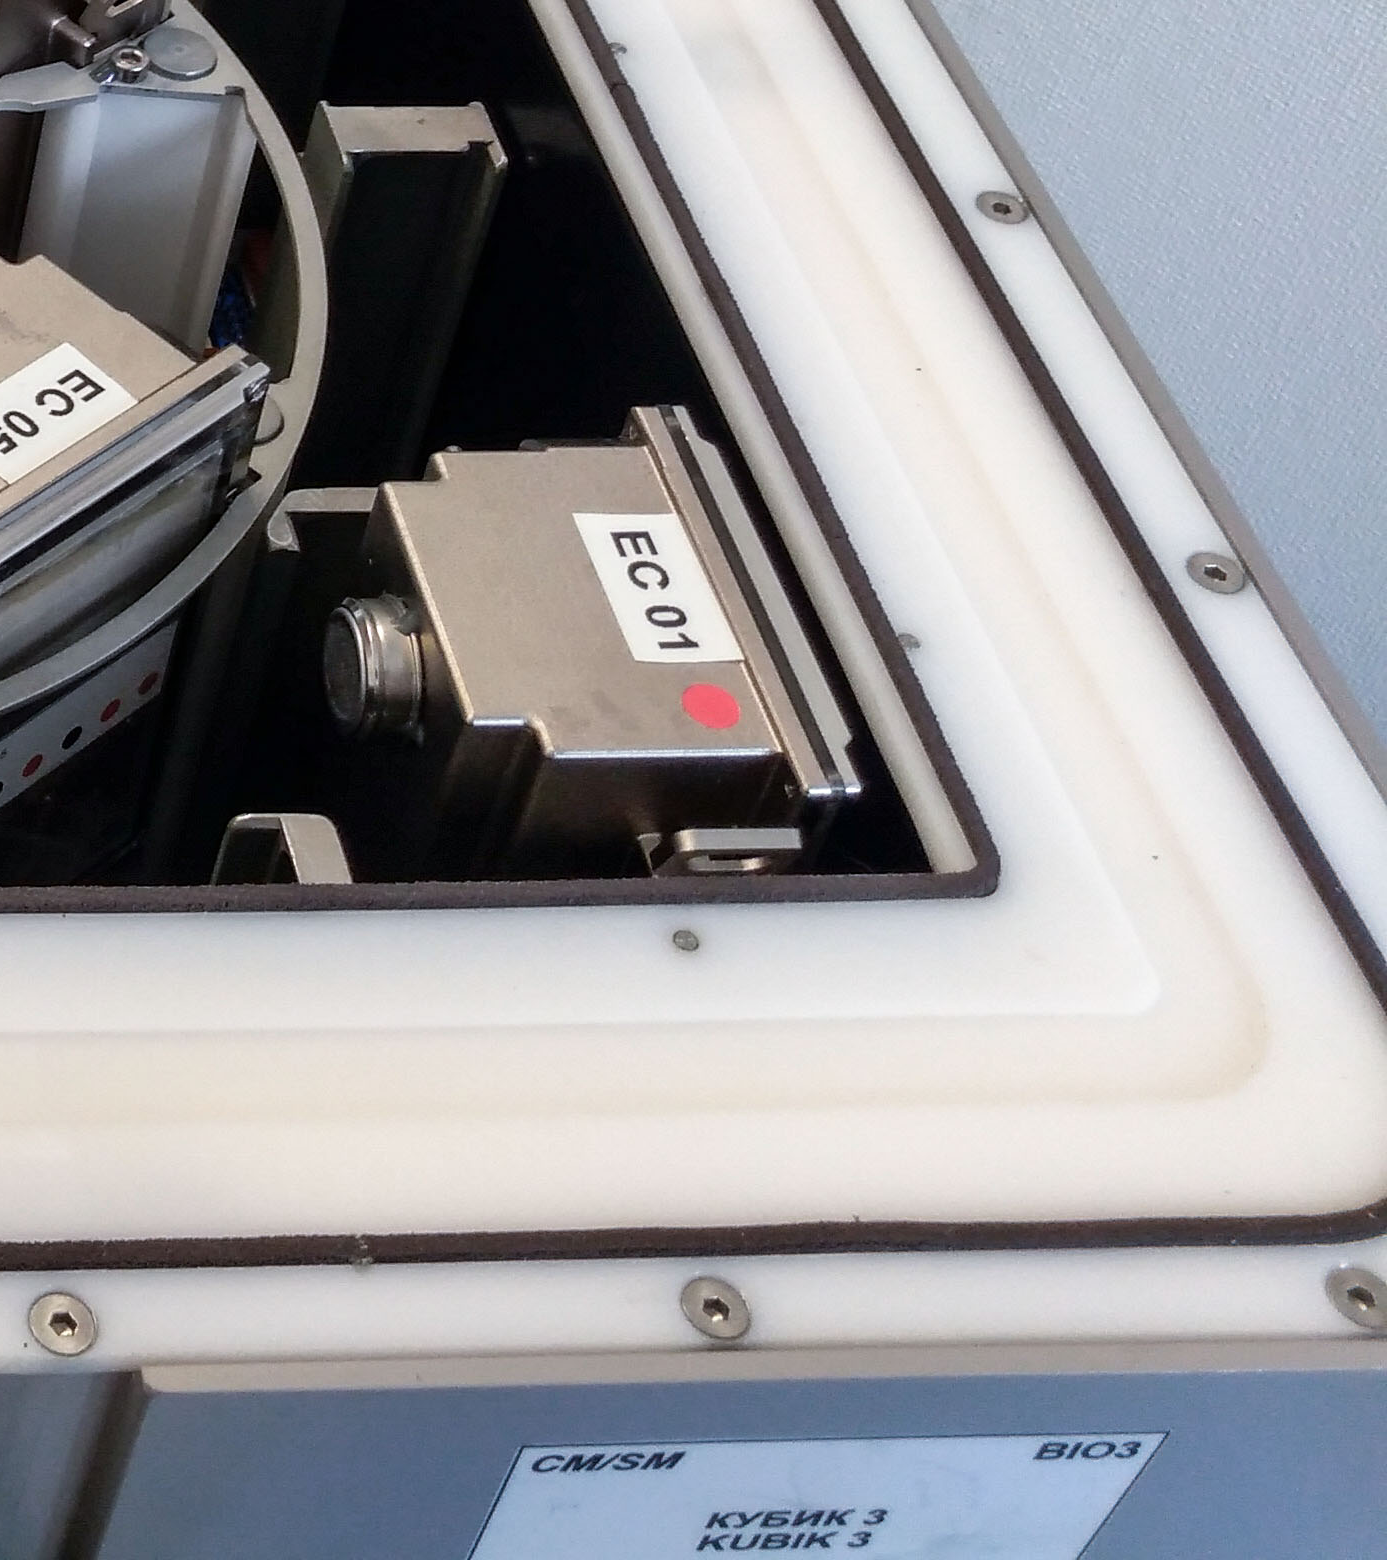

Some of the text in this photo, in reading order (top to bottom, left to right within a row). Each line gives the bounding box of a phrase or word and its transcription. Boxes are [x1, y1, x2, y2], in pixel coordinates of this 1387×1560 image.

[36, 369, 105, 417] EC
[610, 530, 699, 651] EC 01
[1032, 1440, 1142, 1461] BIO3
[531, 1451, 687, 1474] CM/SM
[704, 1508, 889, 1530] КУБИК 3
[695, 1530, 873, 1552] KUBIK 3
